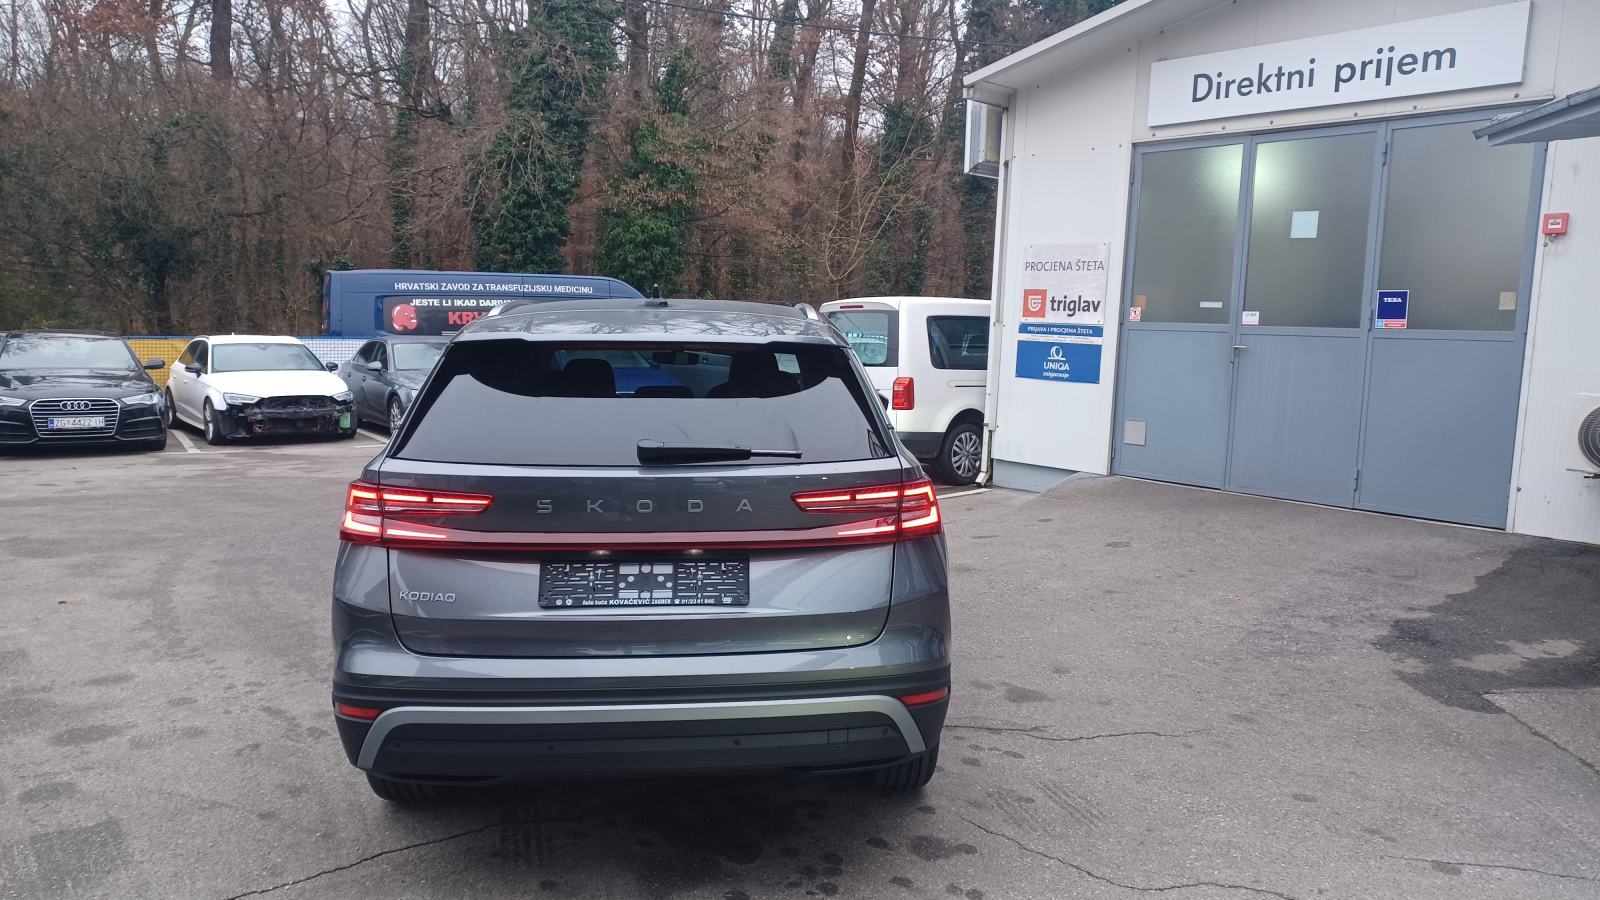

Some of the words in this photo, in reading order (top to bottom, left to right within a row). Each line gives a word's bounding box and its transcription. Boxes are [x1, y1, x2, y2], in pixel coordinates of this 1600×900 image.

[1191, 57, 1316, 103] Direktni
[1334, 45, 1457, 93] prijem
[1025, 261, 1073, 271] PROCJENA
[1075, 258, 1105, 271] ŠTETA
[394, 282, 439, 291] HRVATSKI
[440, 282, 471, 291] ZAVOD
[472, 283, 484, 291] ZA
[484, 283, 553, 293] TRANSFUZIJSKU
[554, 284, 593, 294] MEDICINU
[409, 298, 440, 307] JESTE
[442, 299, 451, 307] LI
[453, 299, 476, 307] IKAD
[1050, 294, 1102, 317] triglav
[1027, 325, 1047, 333] PRIJAVA
[1050, 326, 1077, 334] PROCJENA
[1043, 361, 1070, 371] UNIQA
[1042, 371, 1070, 379] osiguranje
